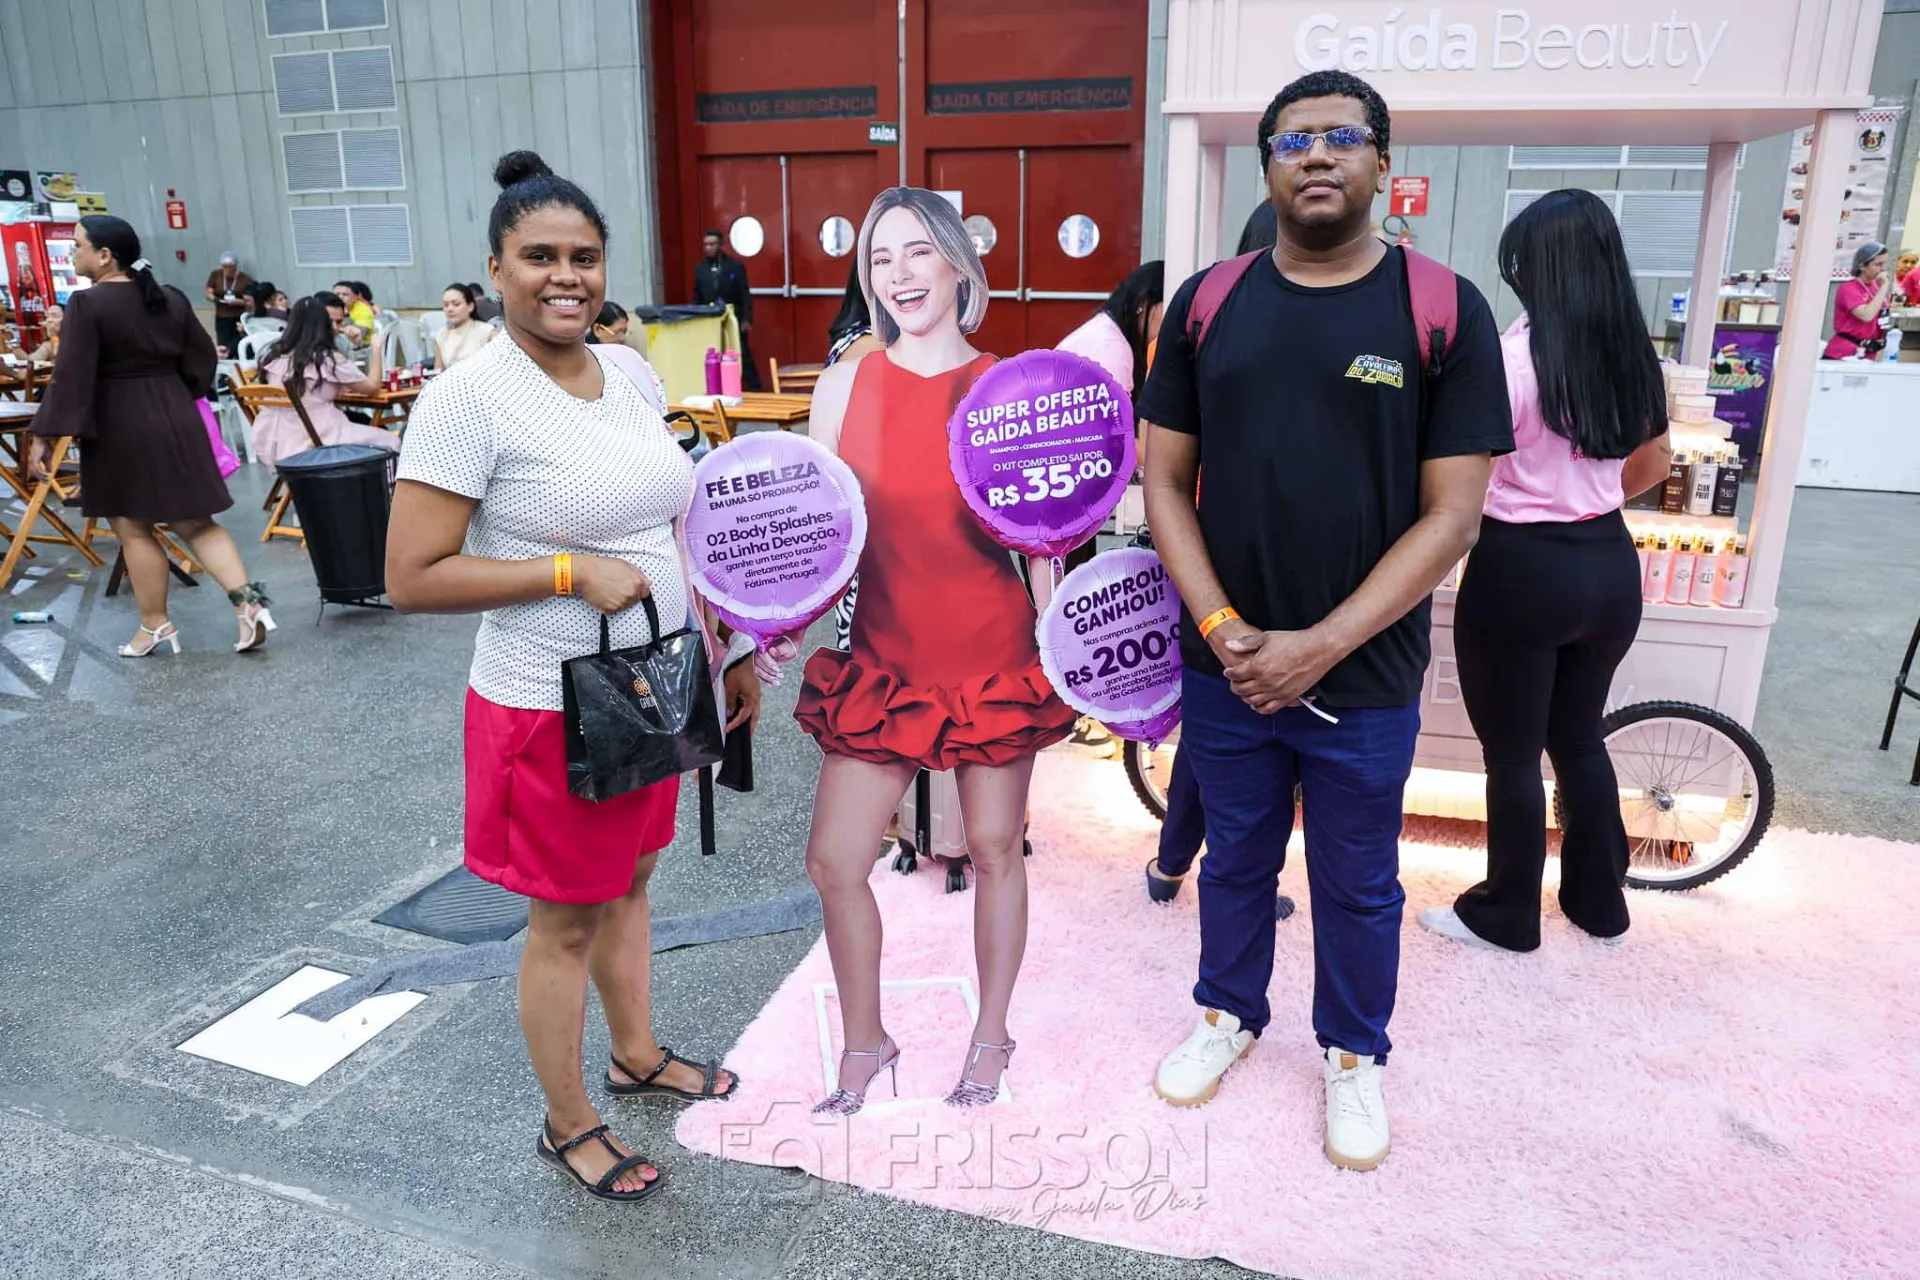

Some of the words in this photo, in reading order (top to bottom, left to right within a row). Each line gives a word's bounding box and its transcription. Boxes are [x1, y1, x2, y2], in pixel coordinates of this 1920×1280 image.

[1294, 6, 1477, 72] Gaída
[1491, 8, 1728, 86] Beauty
[987, 91, 1009, 106] DE
[1014, 85, 1128, 106] EMERGÊNCIA
[869, 124, 897, 141] SAÍDA
[967, 400, 1031, 429] SUPER
[1034, 383, 1110, 413] OFERTA
[970, 421, 1033, 447] GAÍDA
[1036, 399, 1119, 433] BEAUTY!
[993, 463, 1001, 472] O
[1002, 460, 1017, 471] KIT
[1017, 454, 1068, 469] COMPLETO
[1069, 452, 1083, 462] SAI
[1084, 450, 1104, 460] POR
[705, 476, 729, 498] FÉ
[732, 479, 744, 493] E
[746, 461, 821, 490] BELEZA
[709, 501, 725, 511] EM
[725, 496, 747, 508] UMA
[747, 491, 761, 503] SÓ
[762, 480, 820, 500] PROMOÇÃO!
[988, 483, 1021, 507] R$
[1022, 459, 1112, 502] 35,00
[706, 532, 728, 547] 02
[729, 523, 768, 542] Body
[769, 510, 833, 536] Splashes
[736, 515, 750, 524] Na
[751, 507, 785, 522] compra
[785, 505, 798, 514] de
[707, 548, 728, 563] da
[729, 539, 770, 559] Linha
[772, 526, 840, 550] Devoção,
[725, 558, 754, 573] ganhe
[755, 555, 769, 565] um
[770, 550, 794, 562] terço
[795, 542, 827, 556] trazido
[744, 576, 779, 590] Fátima,
[745, 560, 800, 578] diretamente
[801, 557, 812, 567] de
[1063, 563, 1170, 619] COMPROU,
[1074, 584, 1165, 636] GANHOU!
[1083, 636, 1099, 647] Nas
[1099, 626, 1134, 645] compras
[1134, 617, 1158, 631] acima
[1159, 613, 1170, 623] de
[1064, 666, 1094, 688] R$
[1092, 623, 1181, 678] 200,0
[1091, 689, 1101, 698] ou
[1102, 684, 1121, 695] uma
[1121, 675, 1152, 690] ecobag
[1105, 673, 1130, 687] ganhe
[1130, 667, 1149, 678] uma
[1149, 660, 1171, 672] blusa
[1109, 692, 1121, 700] da
